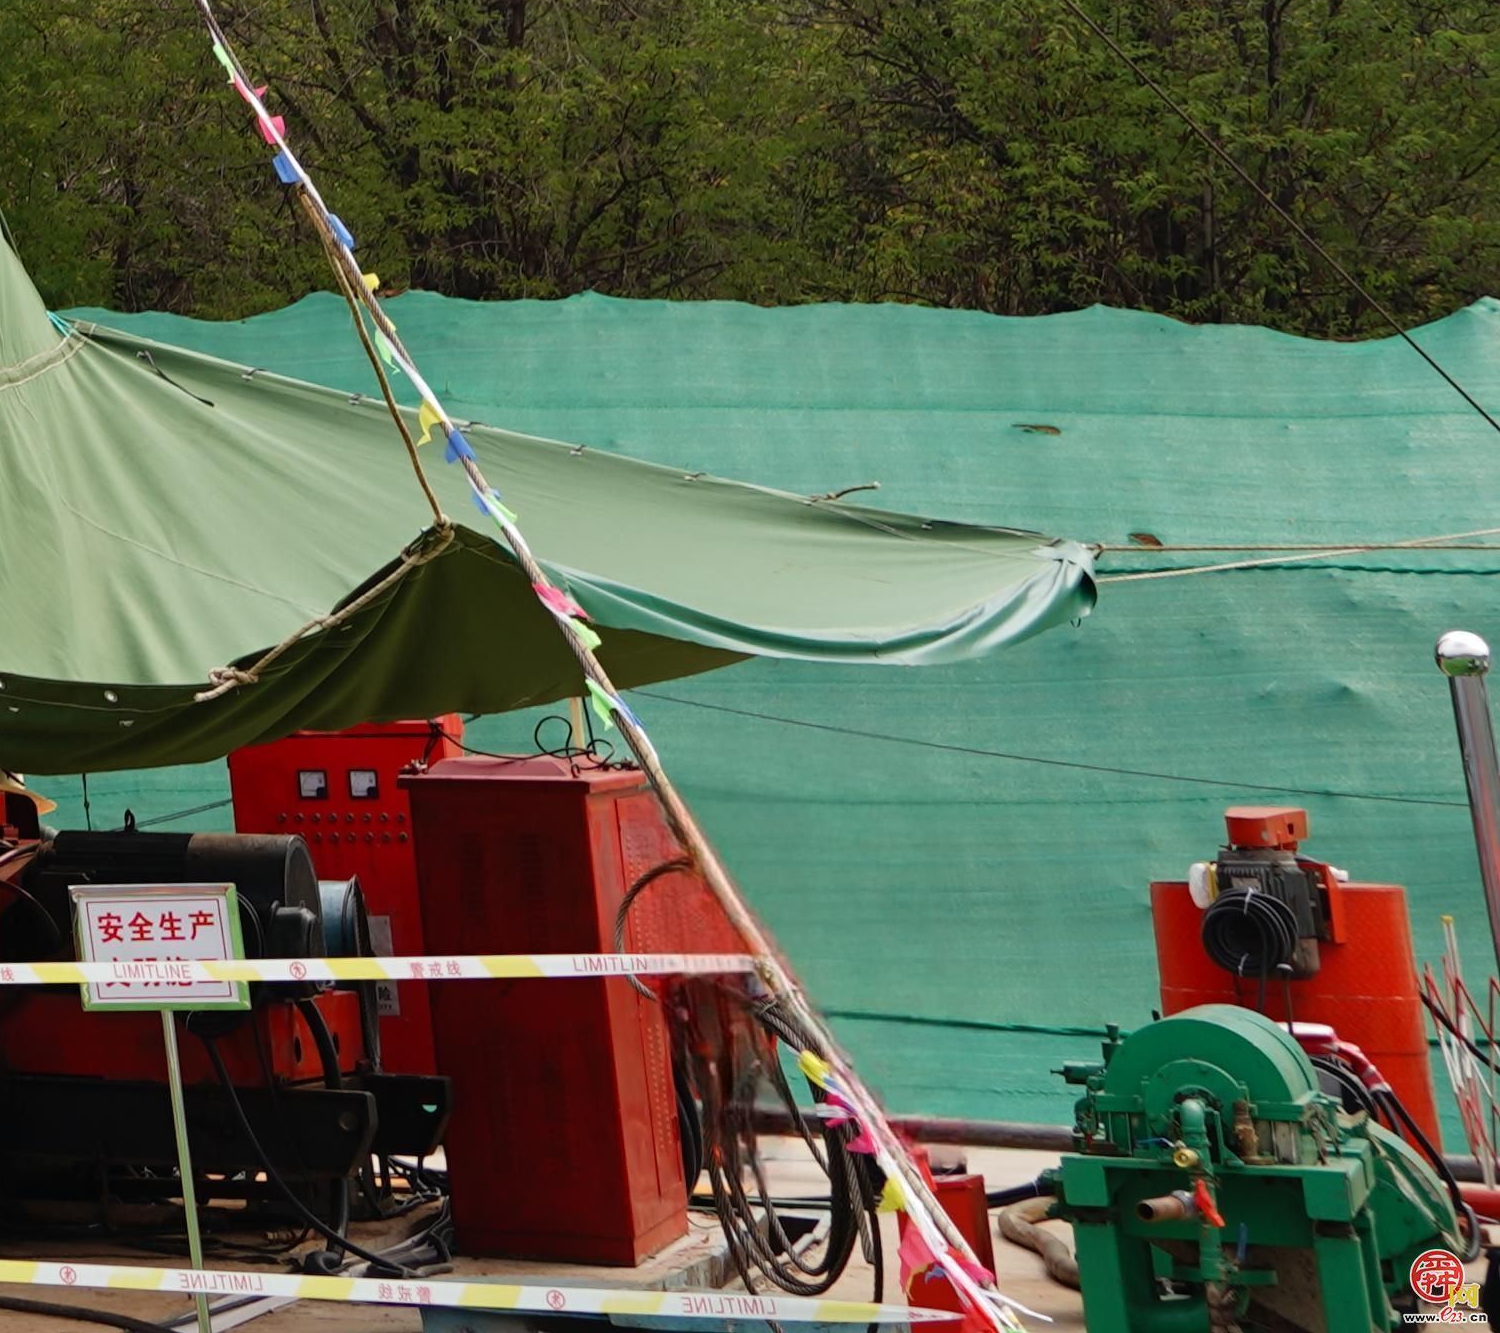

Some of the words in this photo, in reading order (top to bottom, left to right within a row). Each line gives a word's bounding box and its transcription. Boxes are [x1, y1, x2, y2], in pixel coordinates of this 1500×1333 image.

[98, 910, 215, 943] 安全生产
[113, 963, 191, 979] LIMITLINE
[409, 960, 462, 976] 警戒线
